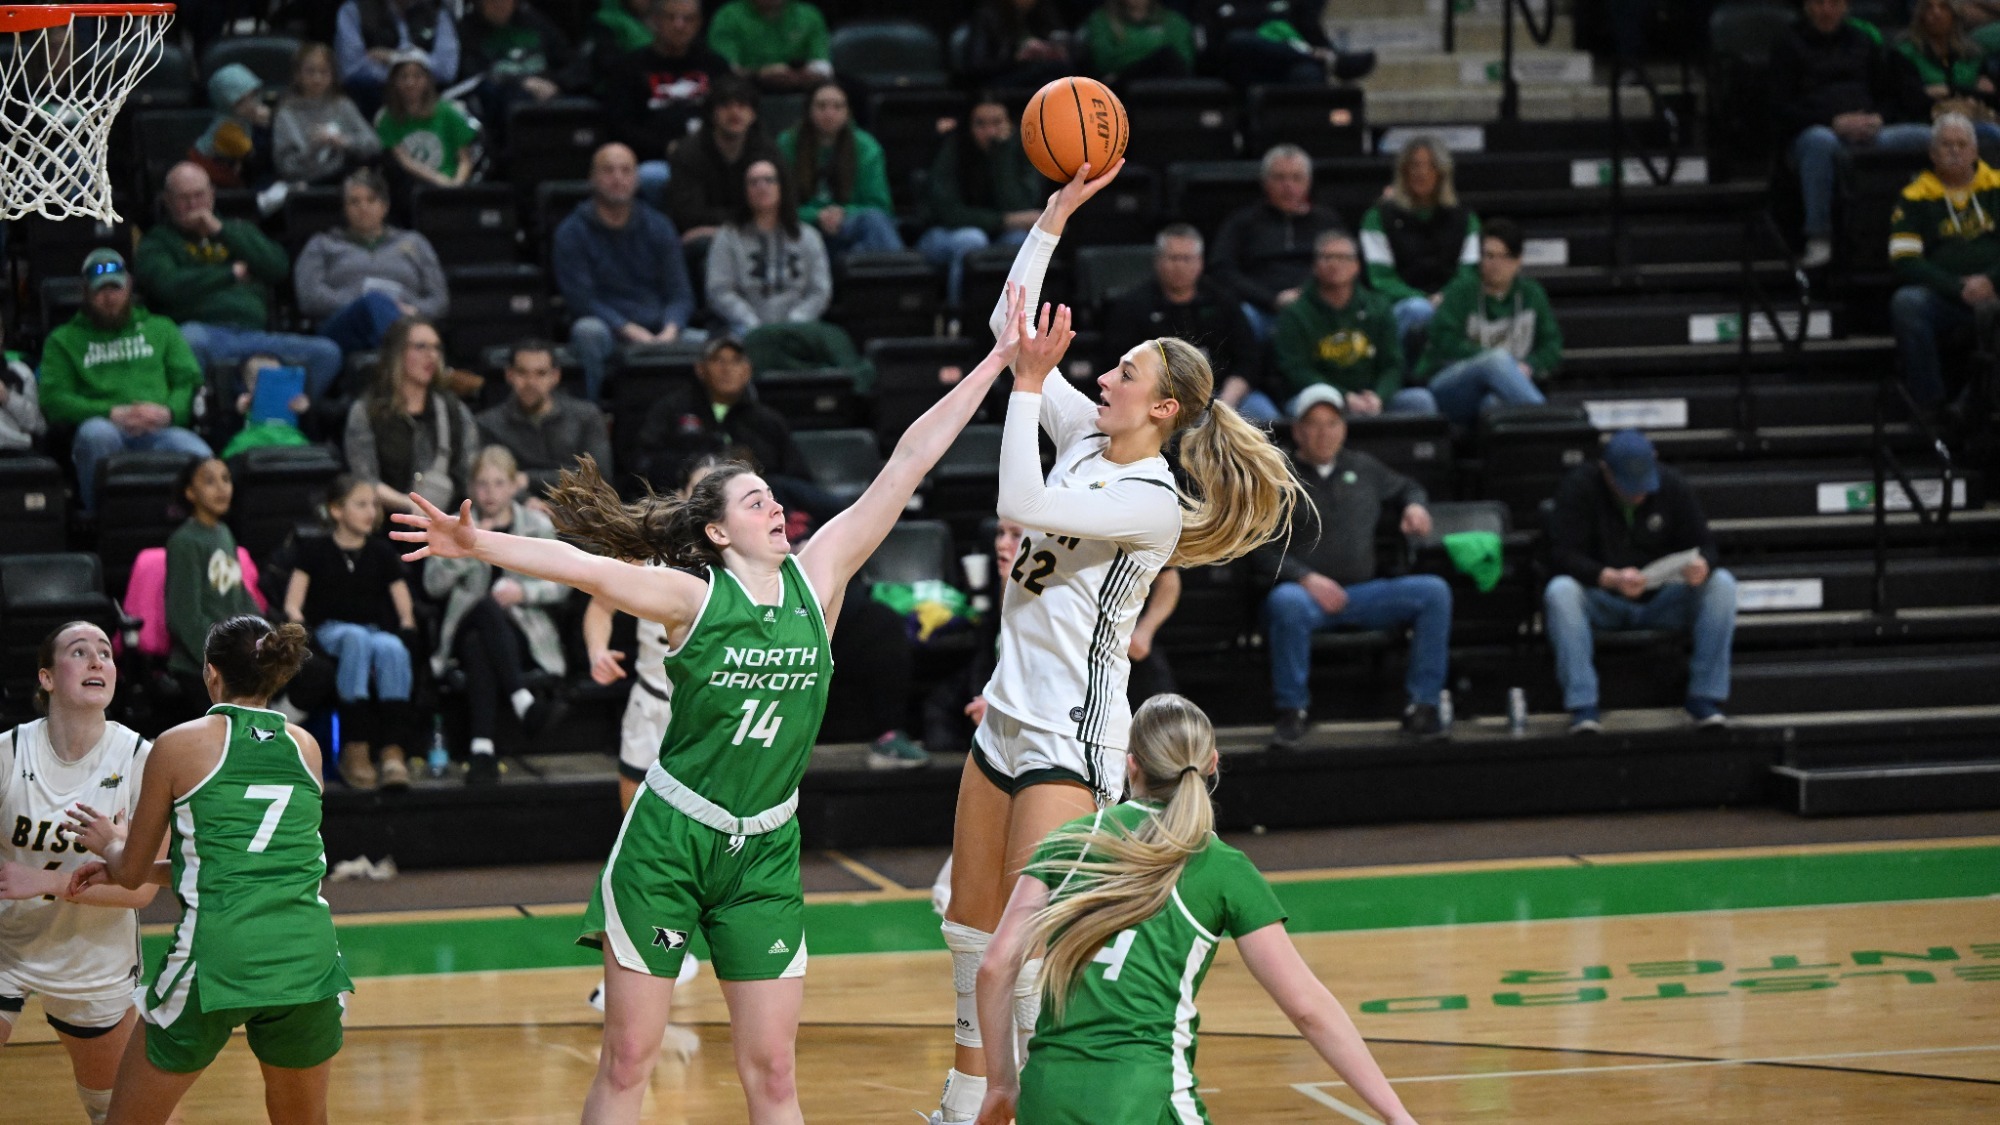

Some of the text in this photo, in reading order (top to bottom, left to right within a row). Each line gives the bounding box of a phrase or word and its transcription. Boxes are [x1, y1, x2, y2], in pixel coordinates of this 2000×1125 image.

[1092, 98, 1110, 139] EVO
[1011, 536, 1057, 596] 22
[723, 646, 818, 669] NORTH
[708, 671, 818, 690] DAKOTA
[731, 699, 783, 748] 14
[12, 815, 118, 853] BIS
[243, 784, 294, 853] 7
